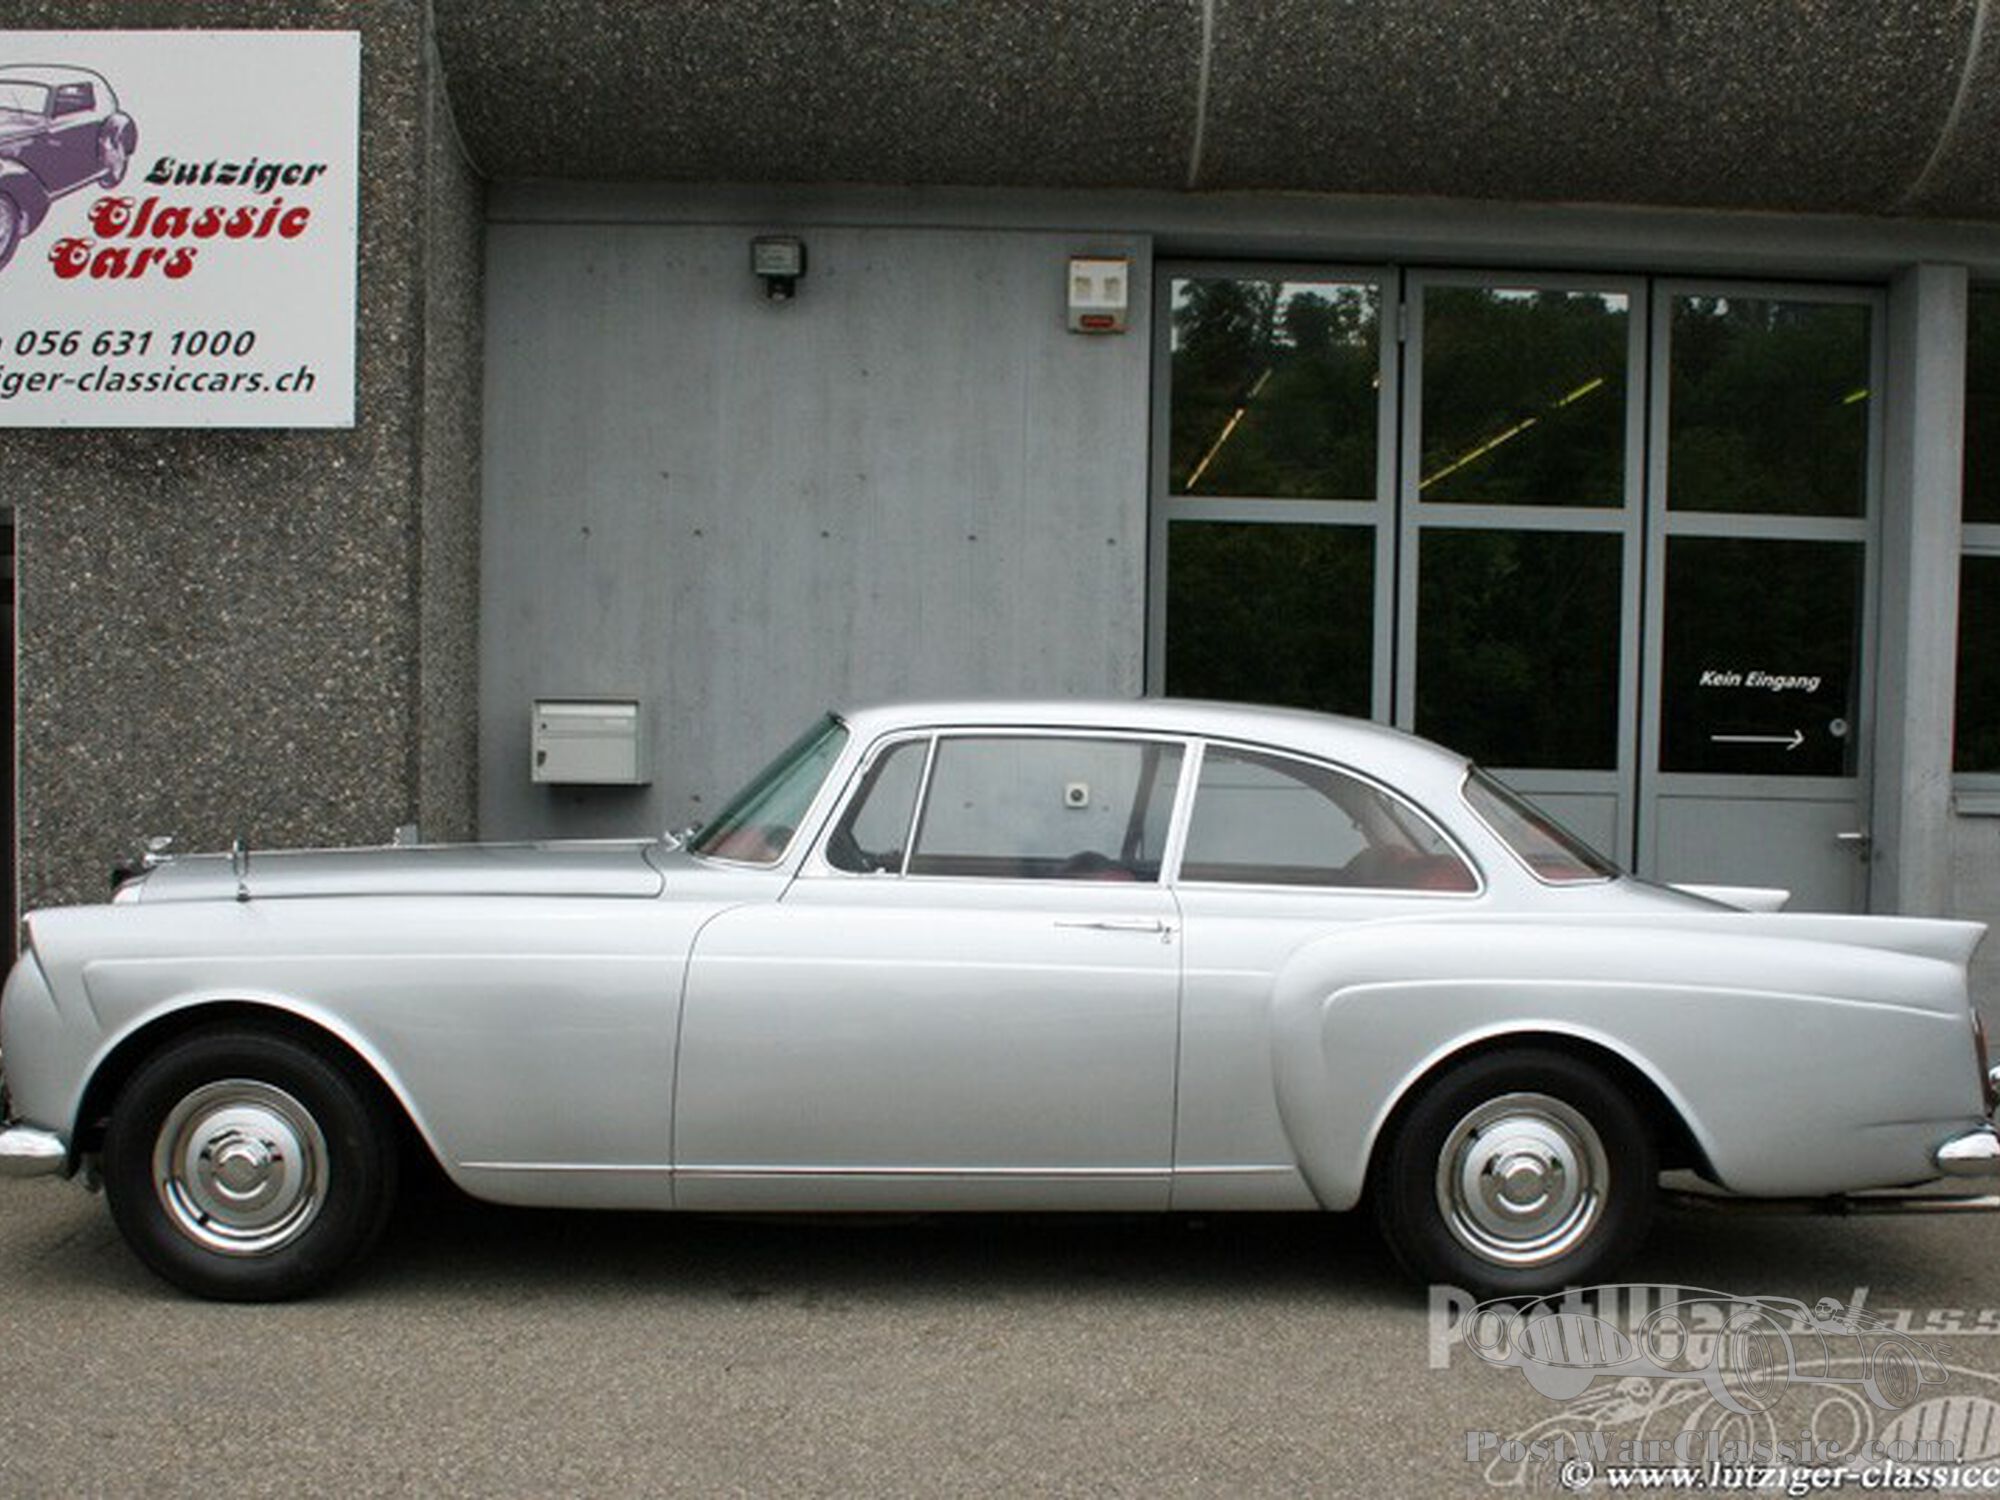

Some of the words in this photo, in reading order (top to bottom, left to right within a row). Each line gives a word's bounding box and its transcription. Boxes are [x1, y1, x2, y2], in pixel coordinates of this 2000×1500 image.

[144, 156, 327, 194] Lutziger
[88, 195, 311, 239] Classic
[48, 237, 198, 279] Cars
[15, 330, 82, 356] 056
[92, 330, 153, 356] 631
[170, 330, 256, 356] 1000
[1700, 670, 1742, 687] Kein
[1745, 670, 1821, 692] Eingang
